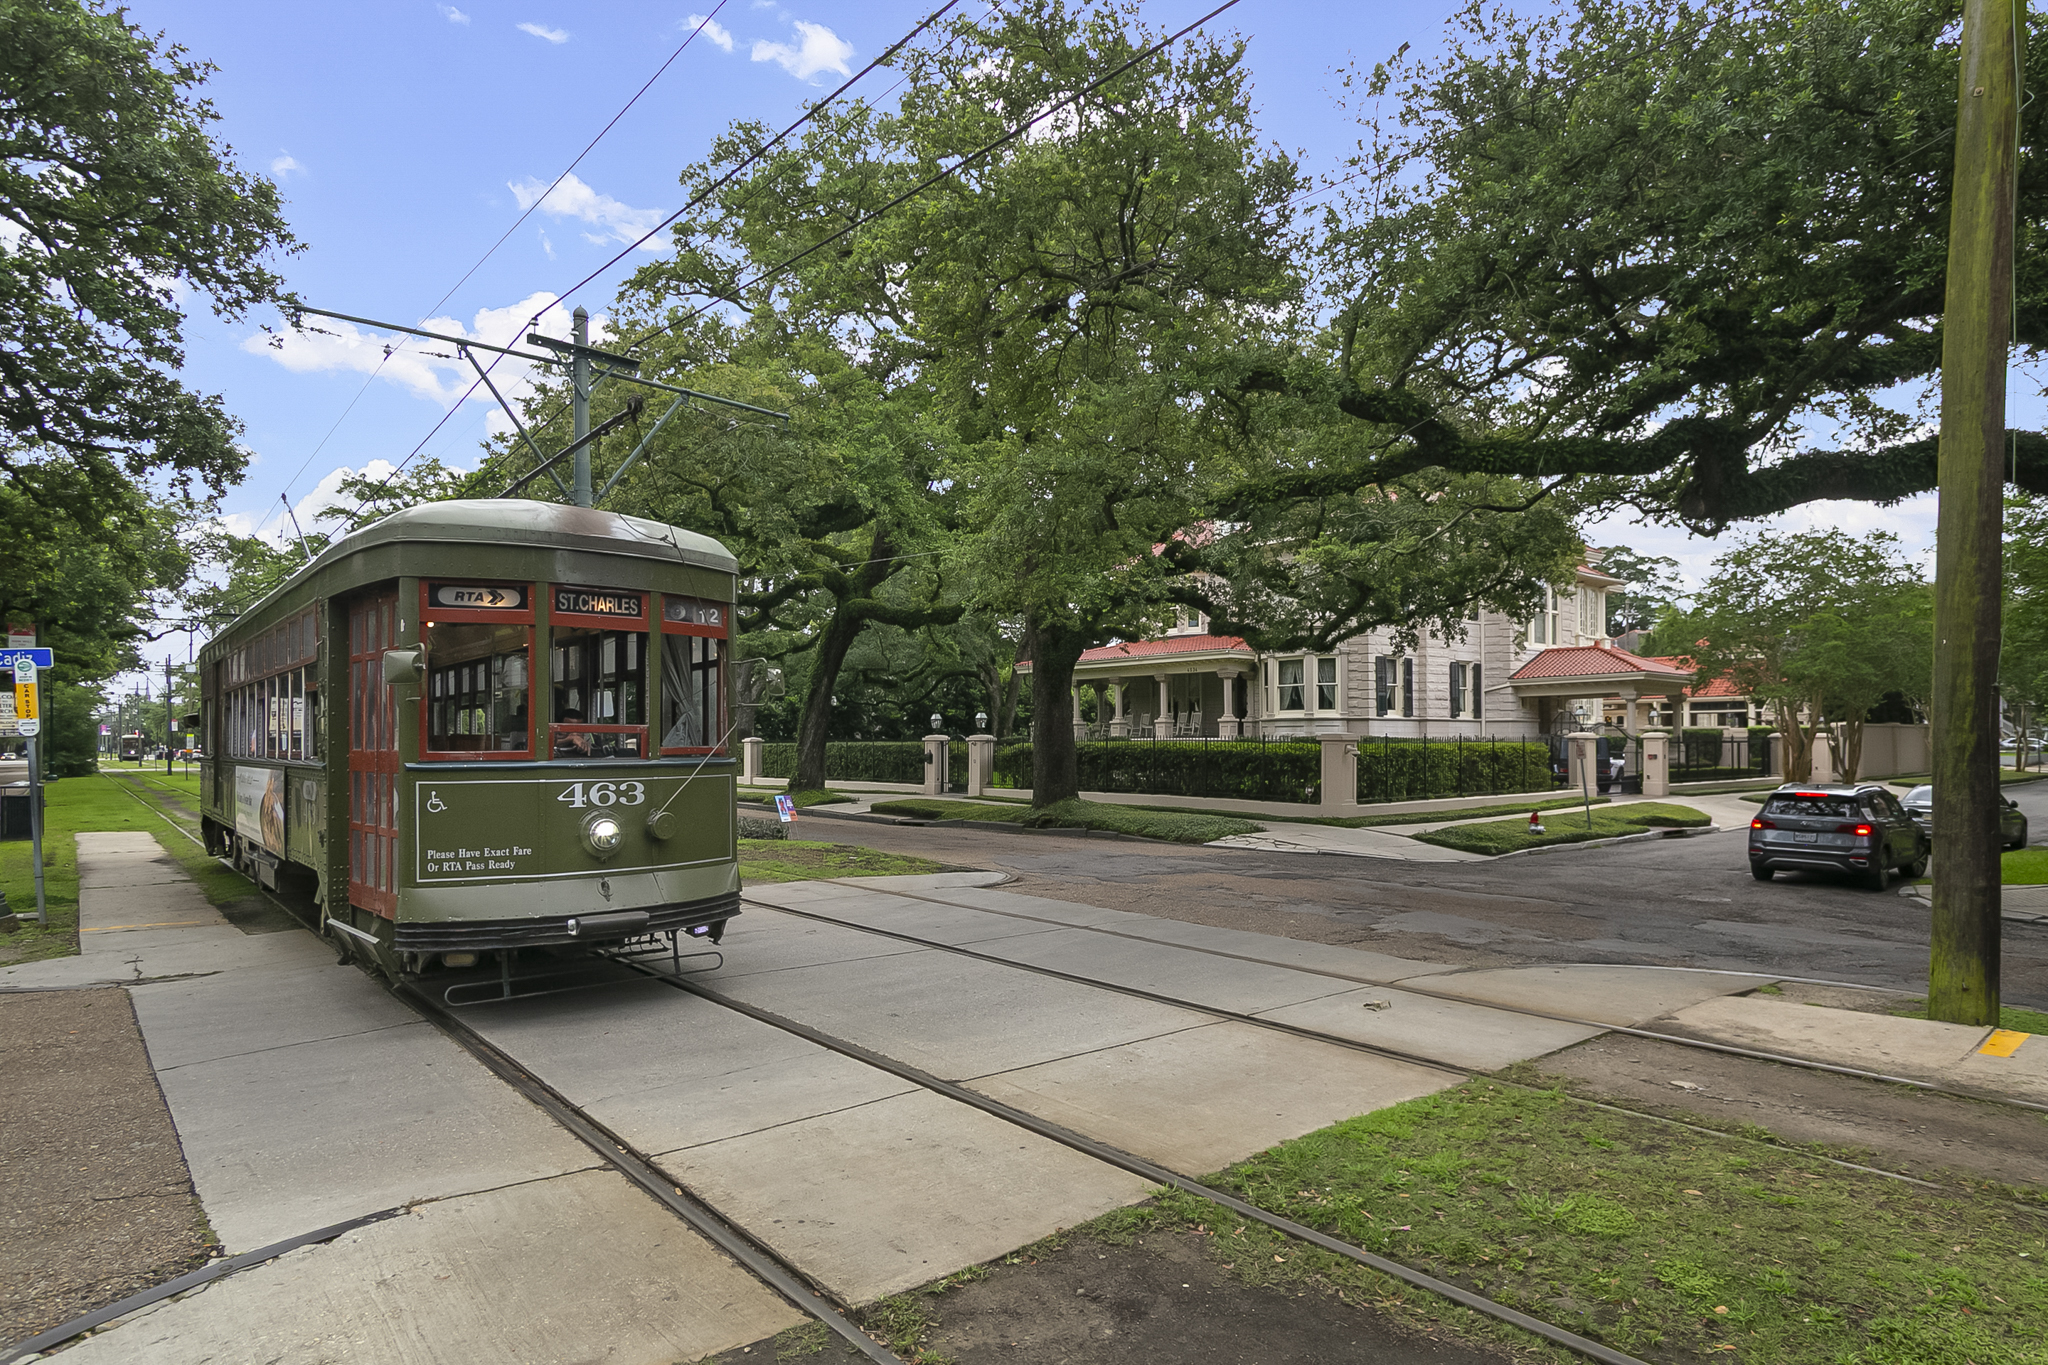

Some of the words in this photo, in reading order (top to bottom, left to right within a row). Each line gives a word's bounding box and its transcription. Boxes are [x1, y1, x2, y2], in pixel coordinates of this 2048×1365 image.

[454, 591, 484, 602] RTA
[699, 608, 719, 623] 12
[556, 781, 646, 808] 463
[427, 849, 455, 859] Please
[458, 848, 480, 858] Have
[484, 847, 510, 857] Exact
[513, 846, 532, 856] Fare
[427, 862, 439, 872] Or
[442, 862, 462, 872] RTA
[466, 861, 485, 871] Pass
[488, 860, 516, 870] Ready
